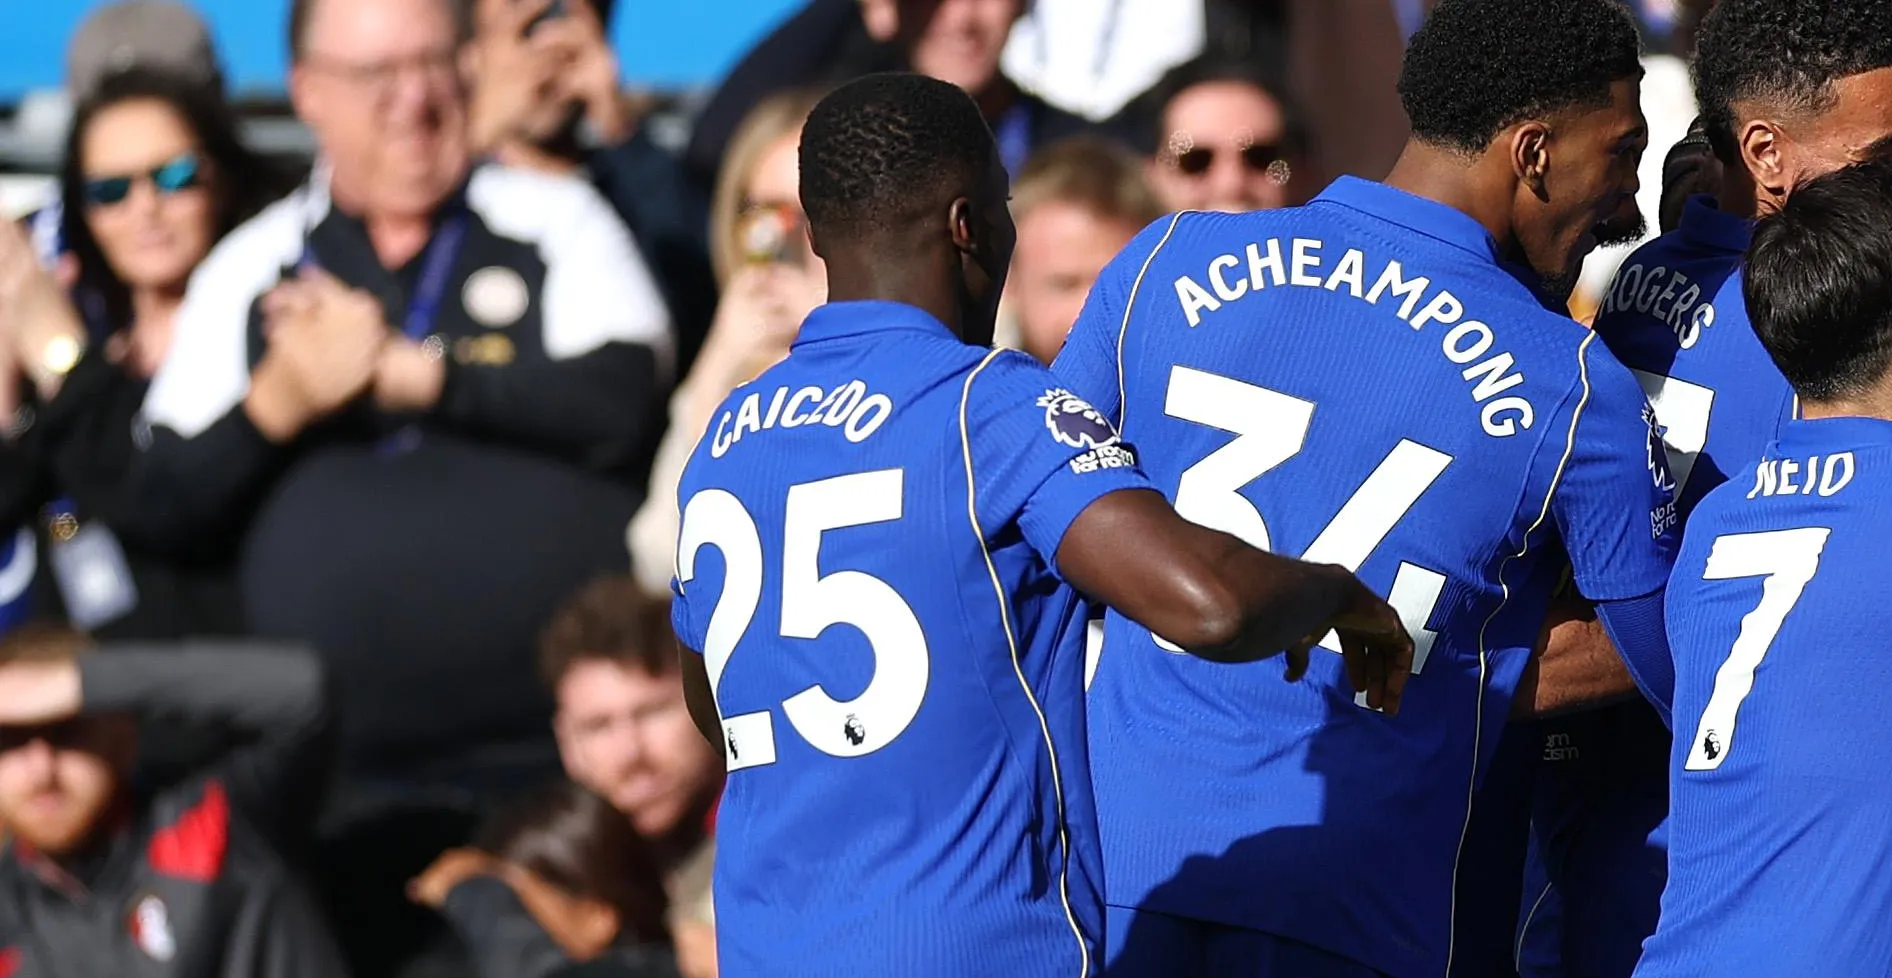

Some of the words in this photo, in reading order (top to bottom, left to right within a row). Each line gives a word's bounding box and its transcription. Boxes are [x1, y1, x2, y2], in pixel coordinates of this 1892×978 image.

[1172, 237, 1535, 439] ACHEAMPONG
[1604, 263, 1715, 350] ROGERS
[710, 379, 893, 460] CAICEDO
[677, 467, 931, 773] 25
[1150, 363, 1455, 711] 34
[1685, 527, 1832, 771] 7
